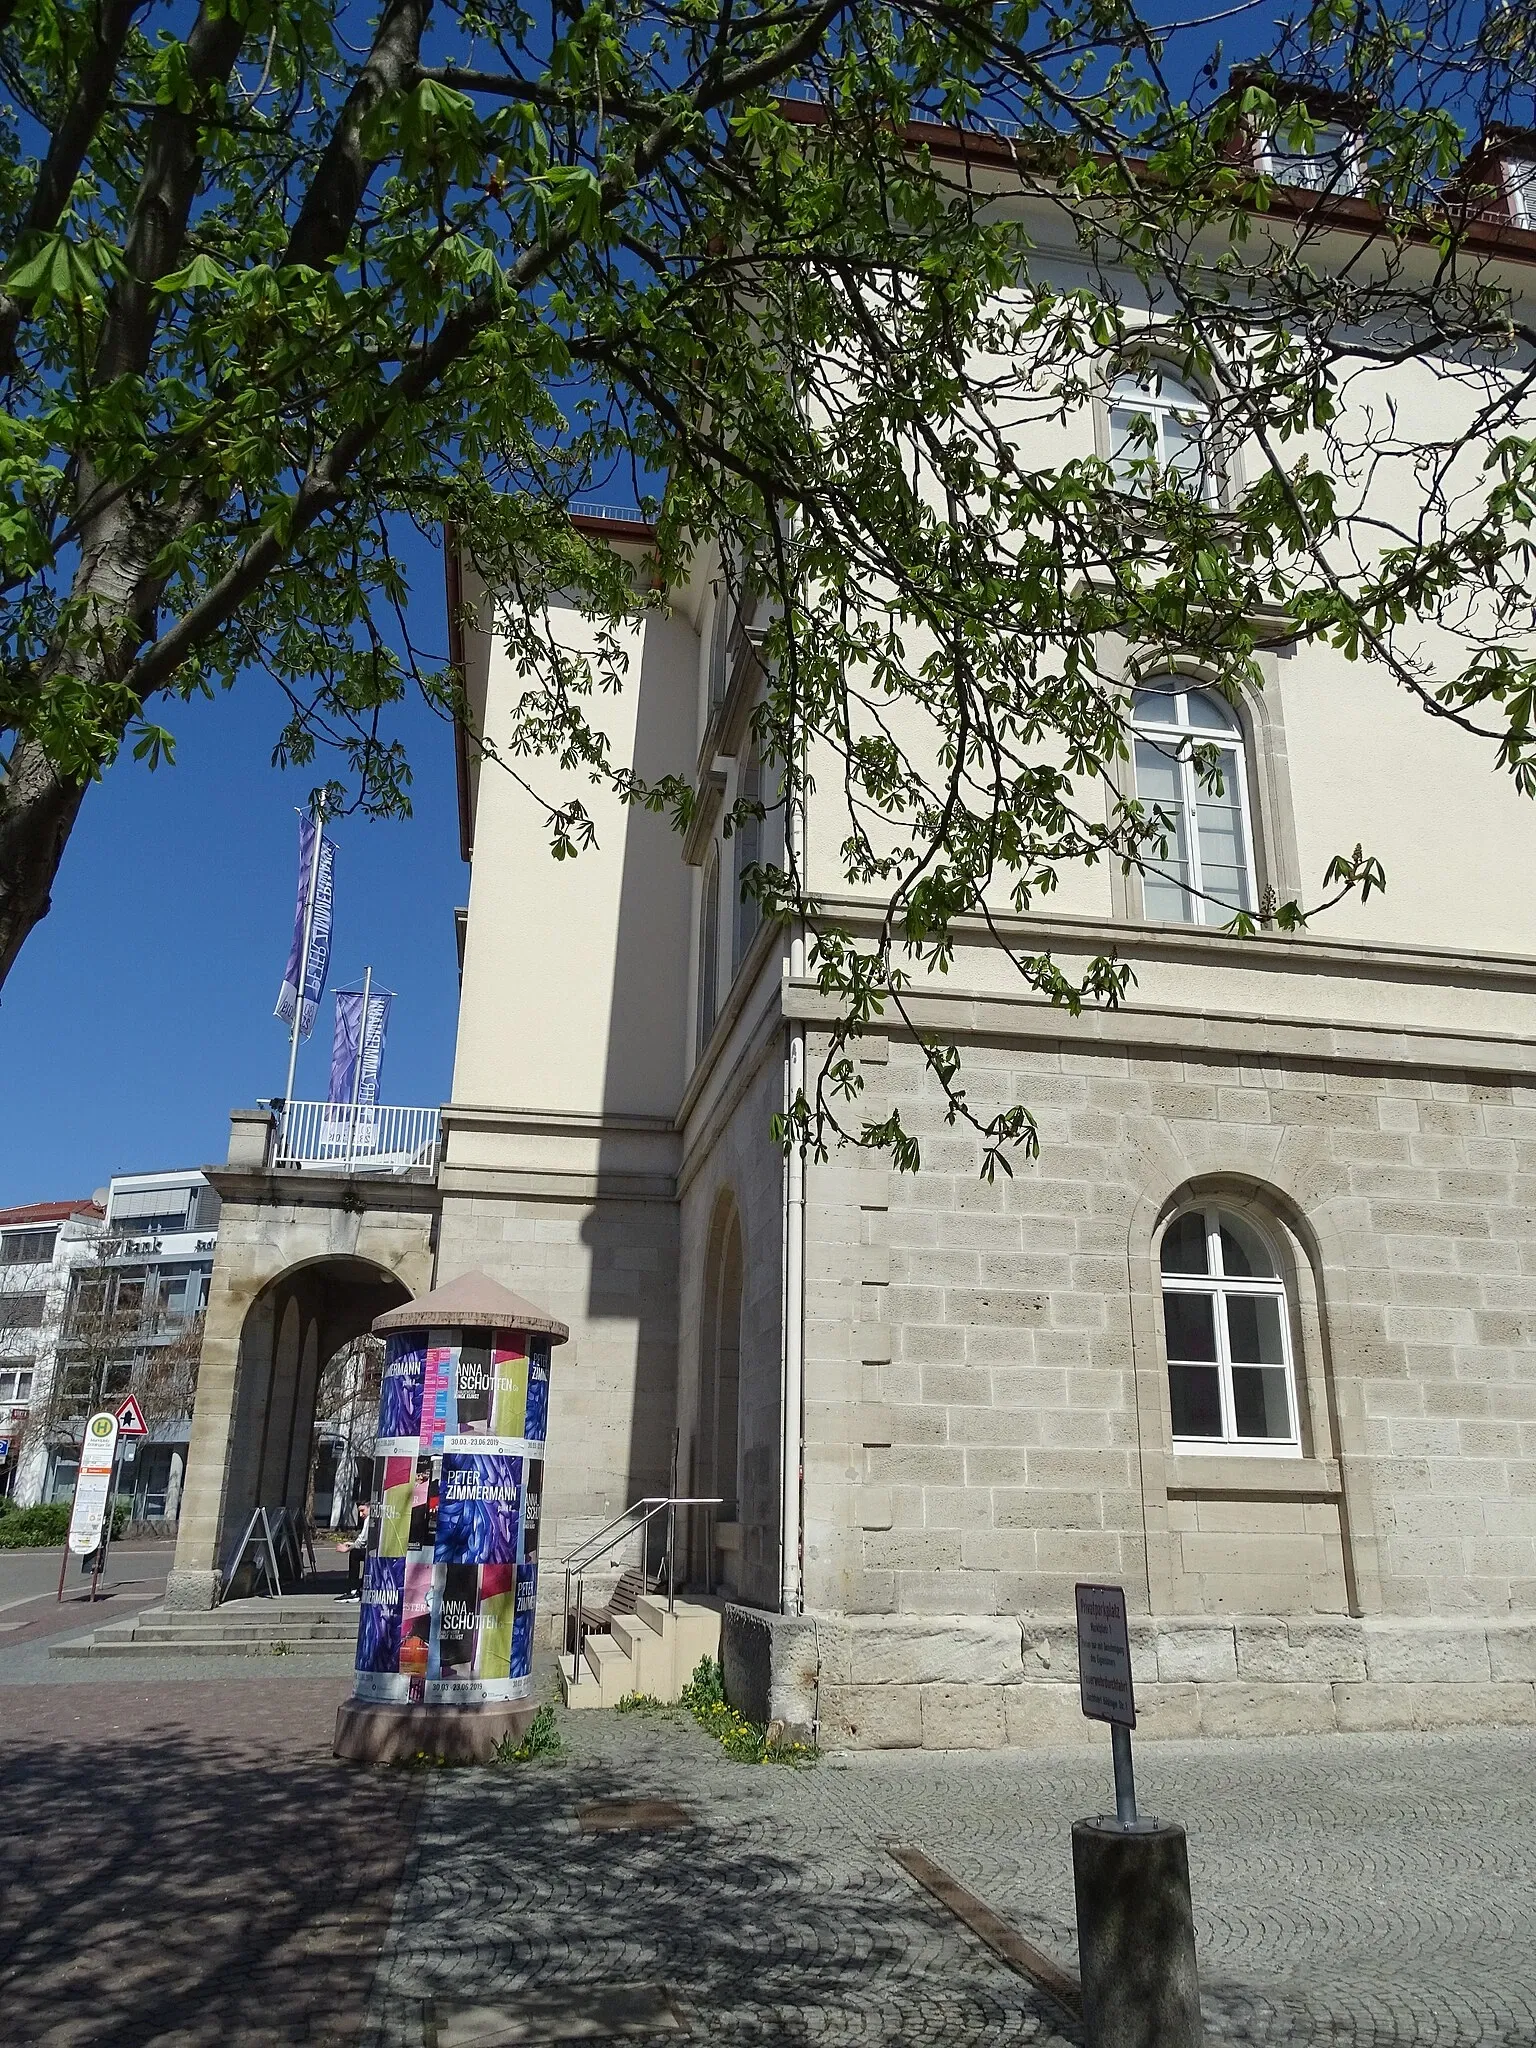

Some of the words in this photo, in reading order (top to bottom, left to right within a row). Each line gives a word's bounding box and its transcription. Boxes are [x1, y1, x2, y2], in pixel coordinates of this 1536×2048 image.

[455, 1363, 482, 1377] ANNA
[460, 1374, 512, 1391] SCHÜTTEN
[448, 1471, 480, 1485] PETER
[446, 1485, 517, 1501] ZIMMERMANN
[439, 1601, 467, 1615] ANNA
[1080, 1598, 1121, 1621] Privatparkplatz
[444, 1612, 498, 1630] SCHÜTTEN
